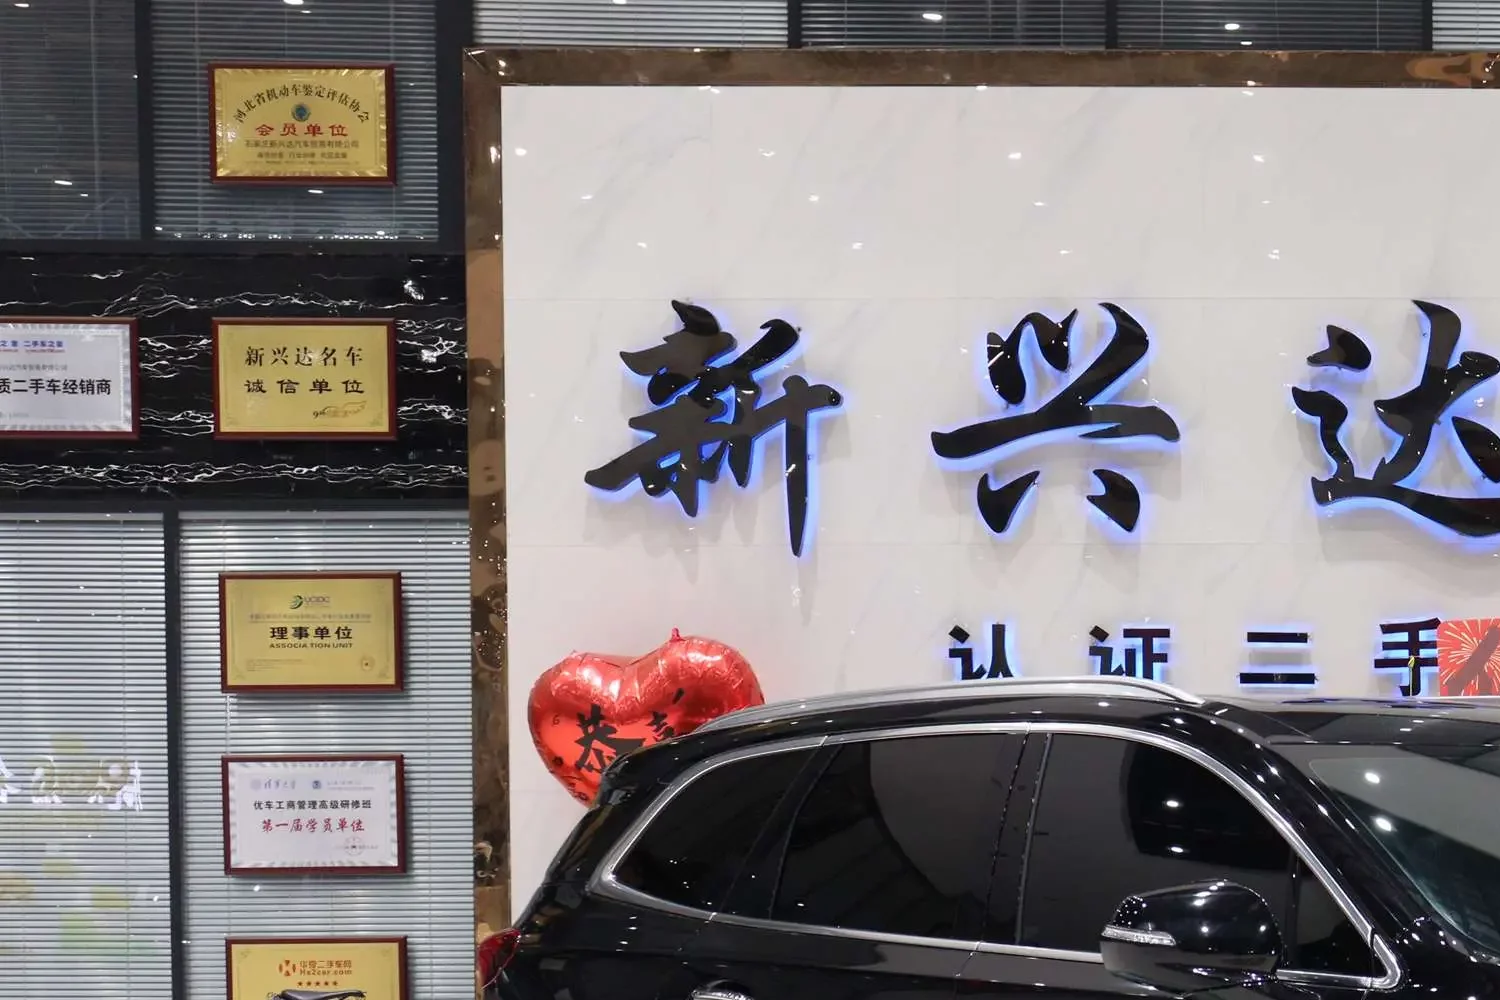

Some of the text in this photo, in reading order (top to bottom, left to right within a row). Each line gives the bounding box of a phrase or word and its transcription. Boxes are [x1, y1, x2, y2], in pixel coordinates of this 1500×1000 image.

[233, 84, 370, 124] 河北省机动车鉴定评估协会
[255, 123, 349, 137] 会员单位
[245, 346, 363, 367] 新兴达名车
[244, 379, 365, 394] 诚信单位
[270, 626, 353, 641] 理事单位
[261, 818, 365, 833] 第一届学员单位
